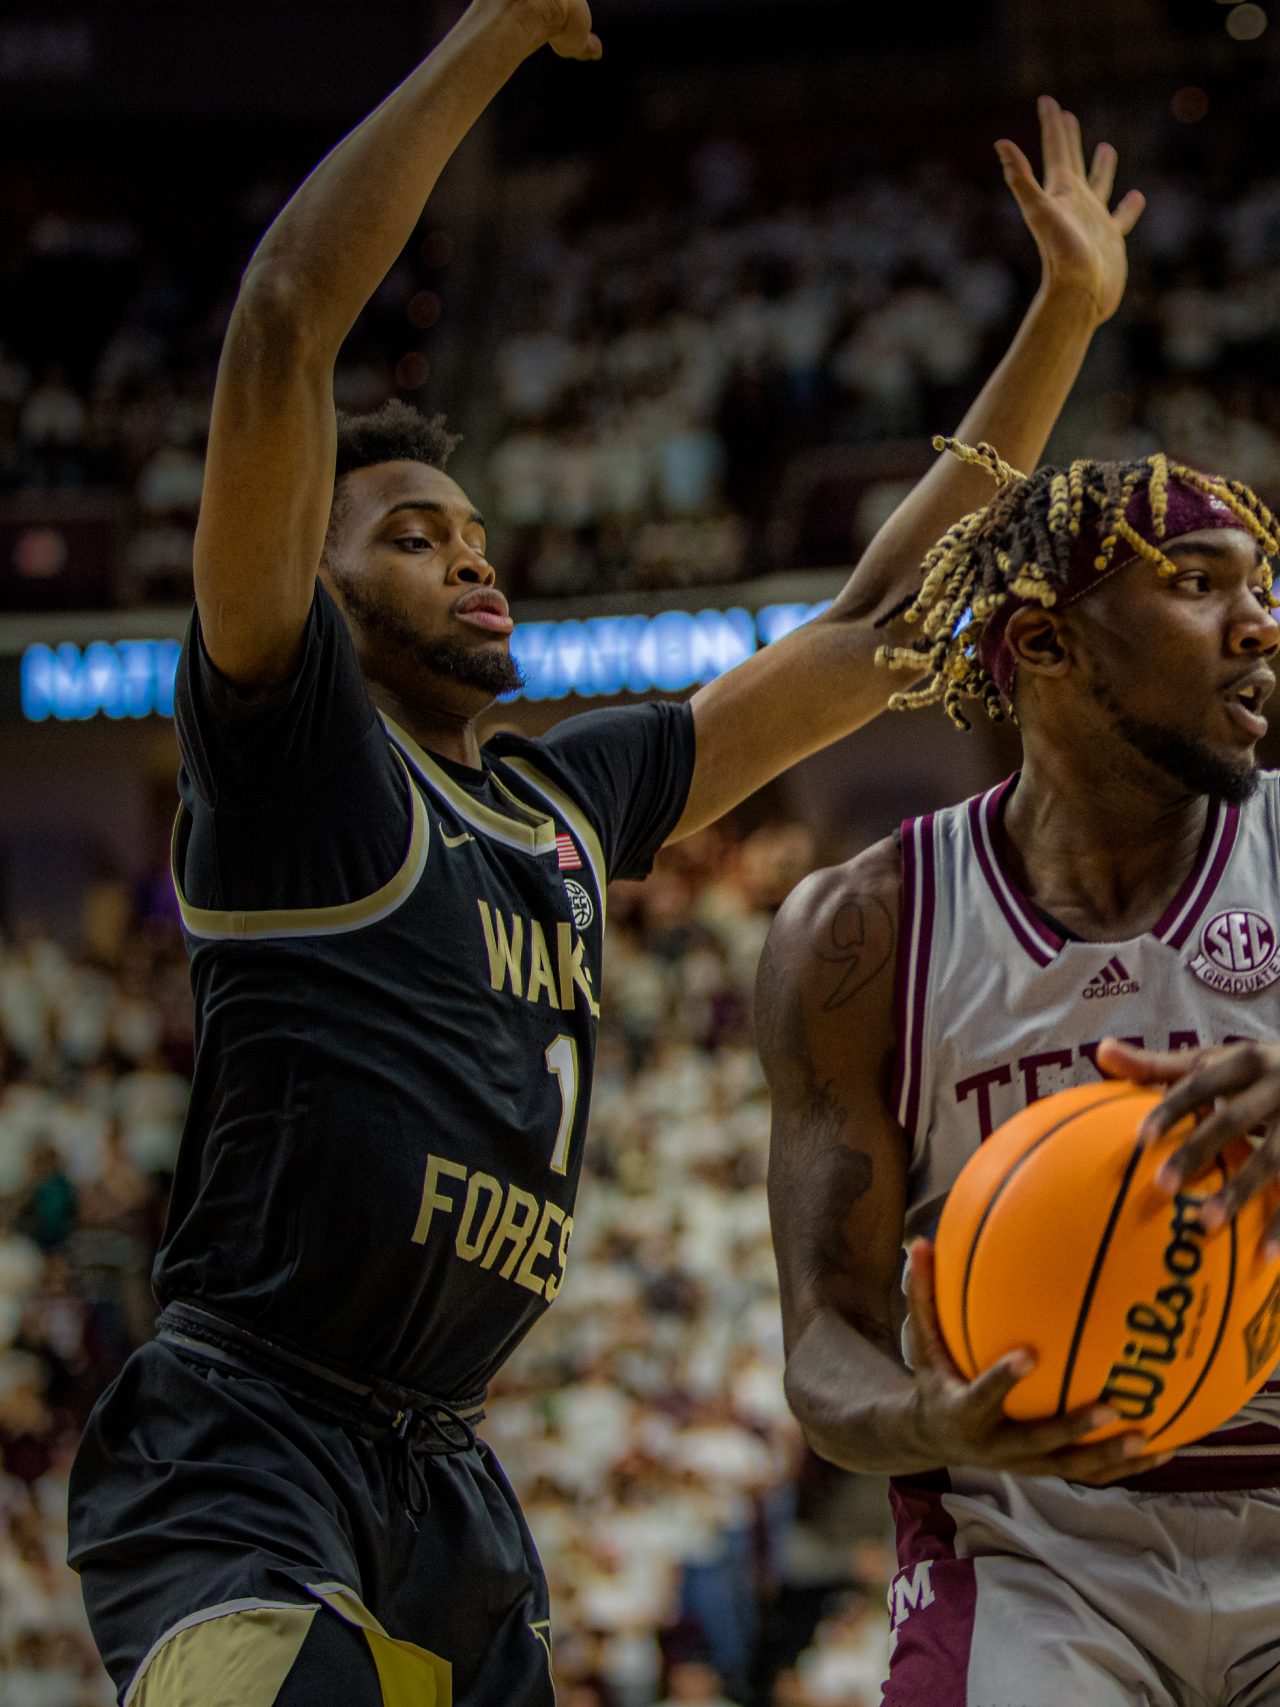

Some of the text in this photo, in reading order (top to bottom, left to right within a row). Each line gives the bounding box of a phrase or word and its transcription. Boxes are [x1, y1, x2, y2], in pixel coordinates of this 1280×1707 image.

[477, 899, 600, 1019] WAK
[1082, 980, 1140, 999] adidas
[1206, 911, 1271, 971] SEC
[544, 1033, 578, 1176] 1
[411, 1153, 574, 1303] FORES
[1099, 1192, 1208, 1421] Wilson
